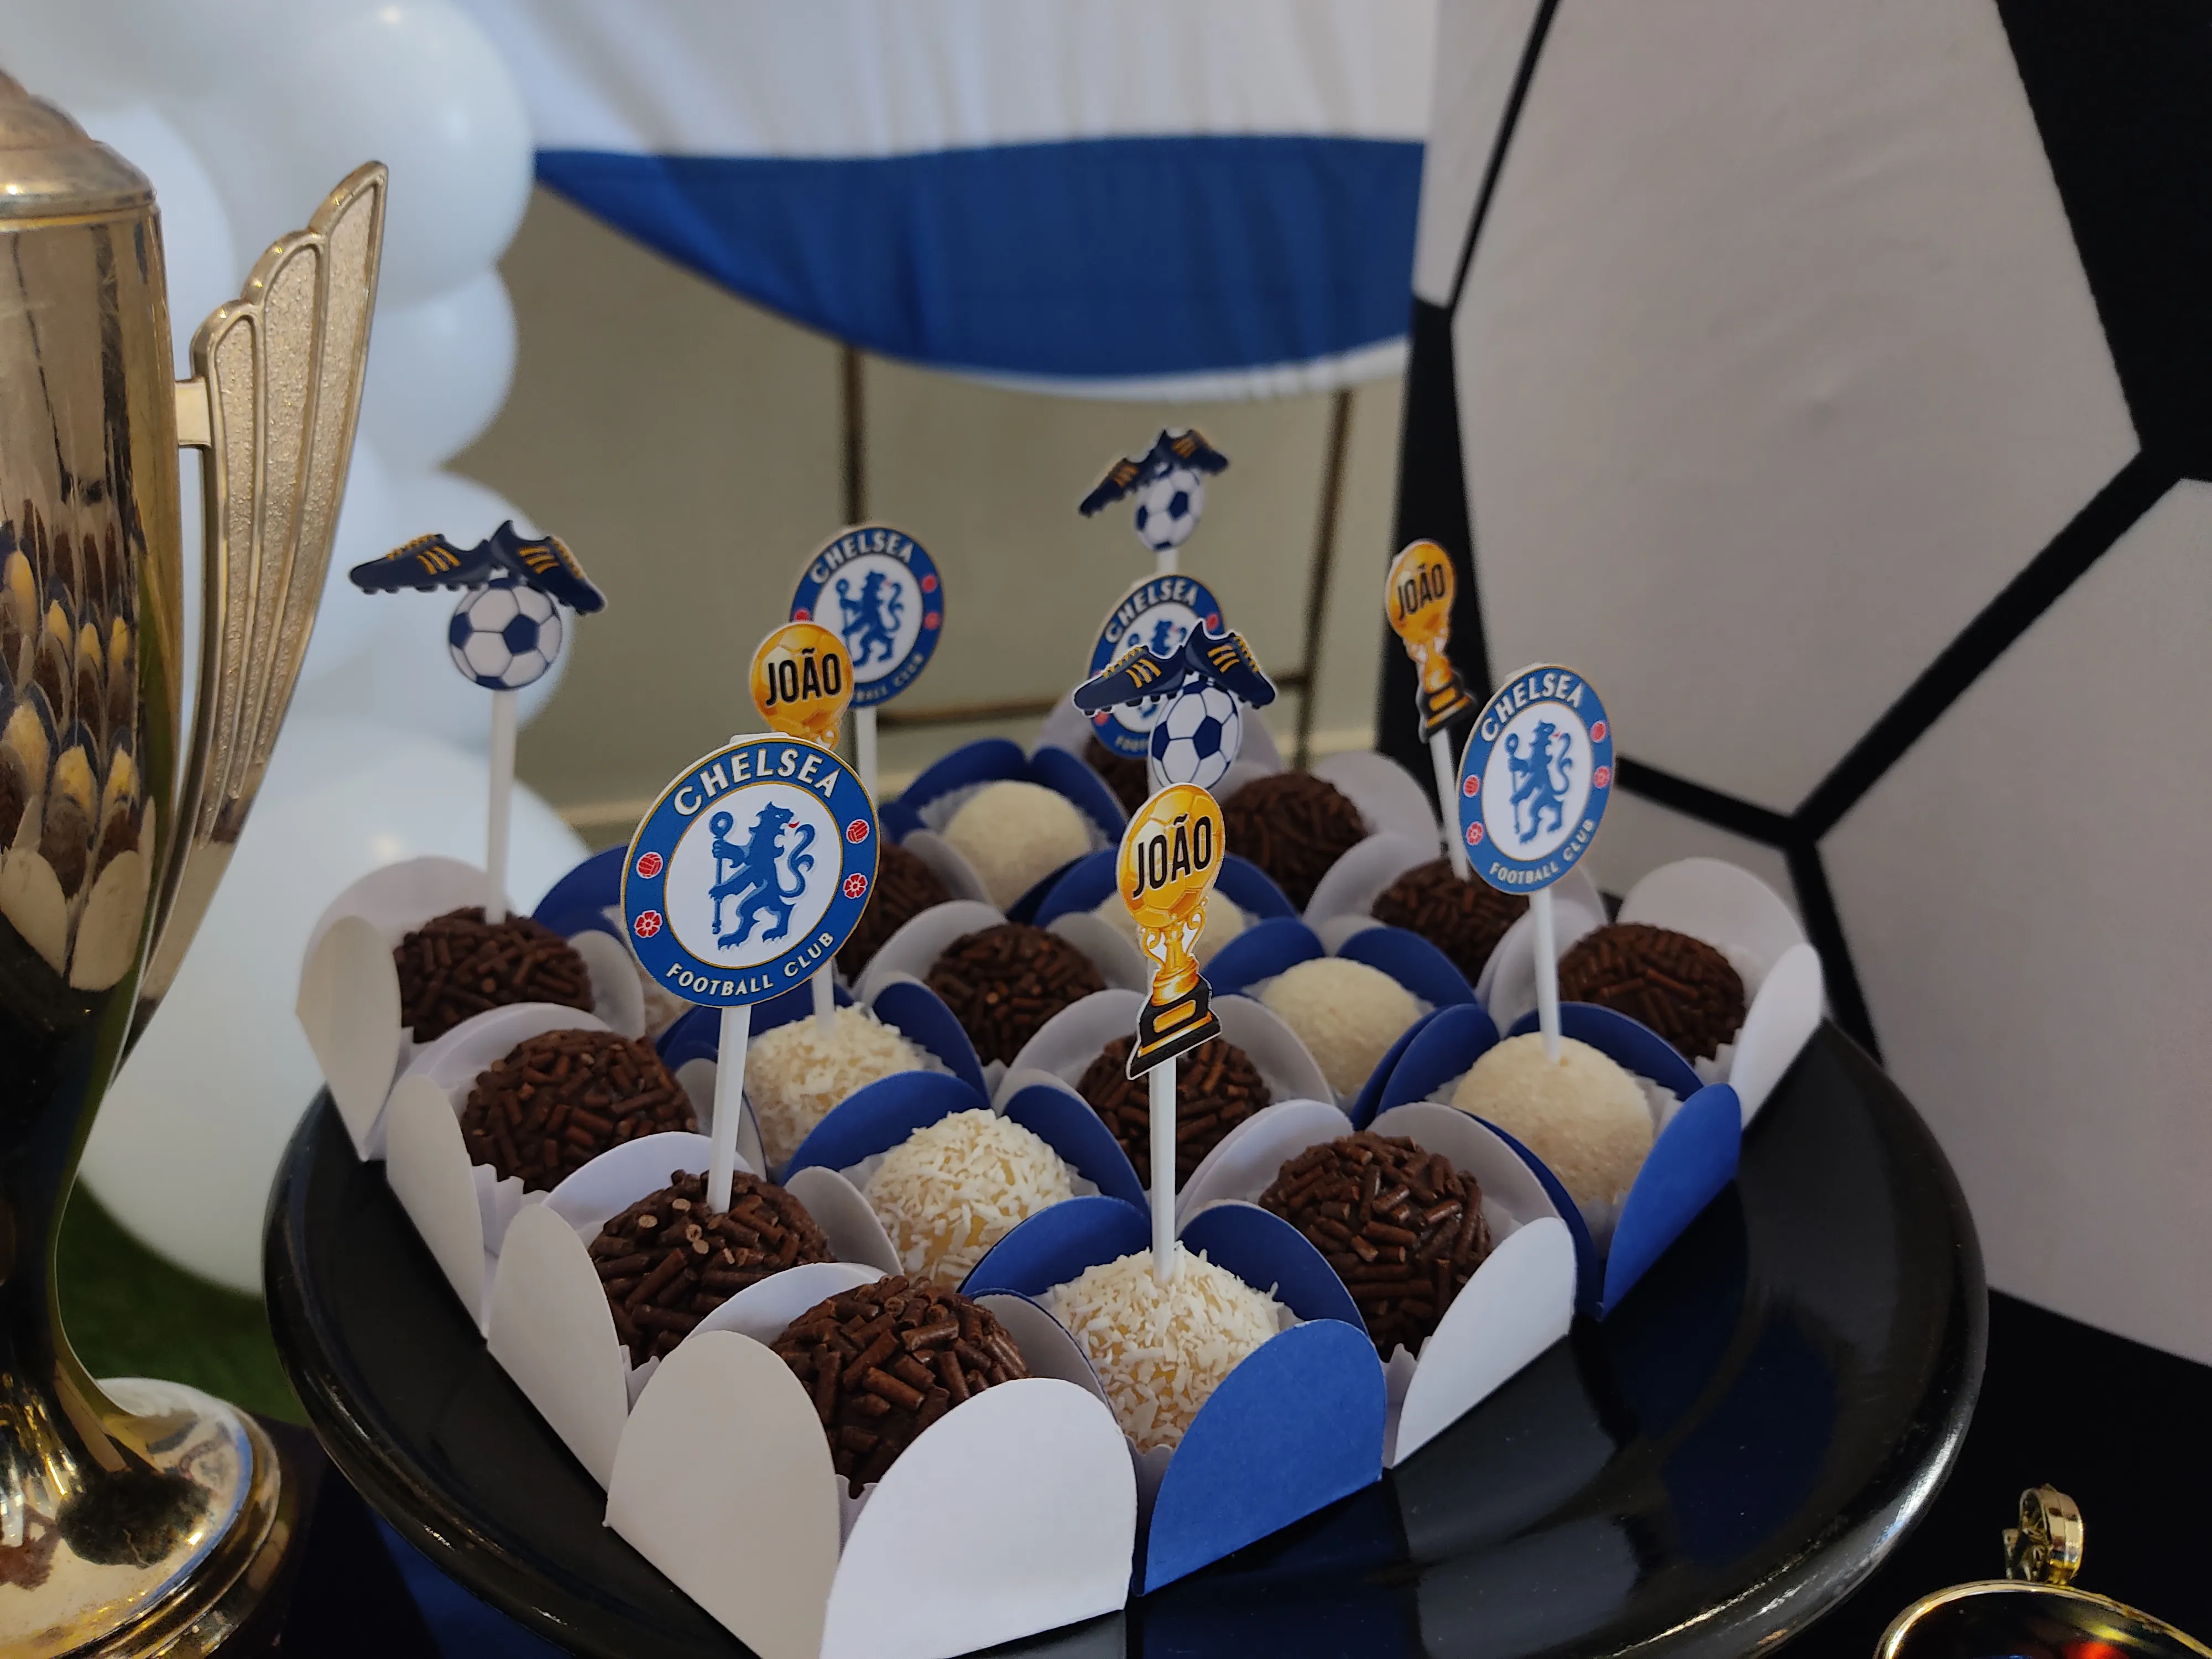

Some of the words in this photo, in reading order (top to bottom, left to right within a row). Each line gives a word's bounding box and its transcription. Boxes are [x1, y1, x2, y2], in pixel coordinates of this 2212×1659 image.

[810, 531, 914, 584] CHELSEA
[1105, 578, 1199, 643] CHELSEA
[1397, 563, 1446, 621] JOÃO
[766, 647, 842, 706] JOÃO
[1481, 673, 1584, 742] CHELSEA
[674, 748, 841, 816] CHELSEA
[1133, 813, 1212, 898] JOÃO
[1490, 862, 1558, 885] FOOTBALL
[1563, 819, 1594, 860] CLUB
[666, 962, 774, 997] FOOTBALL
[784, 931, 833, 977] CLUB
